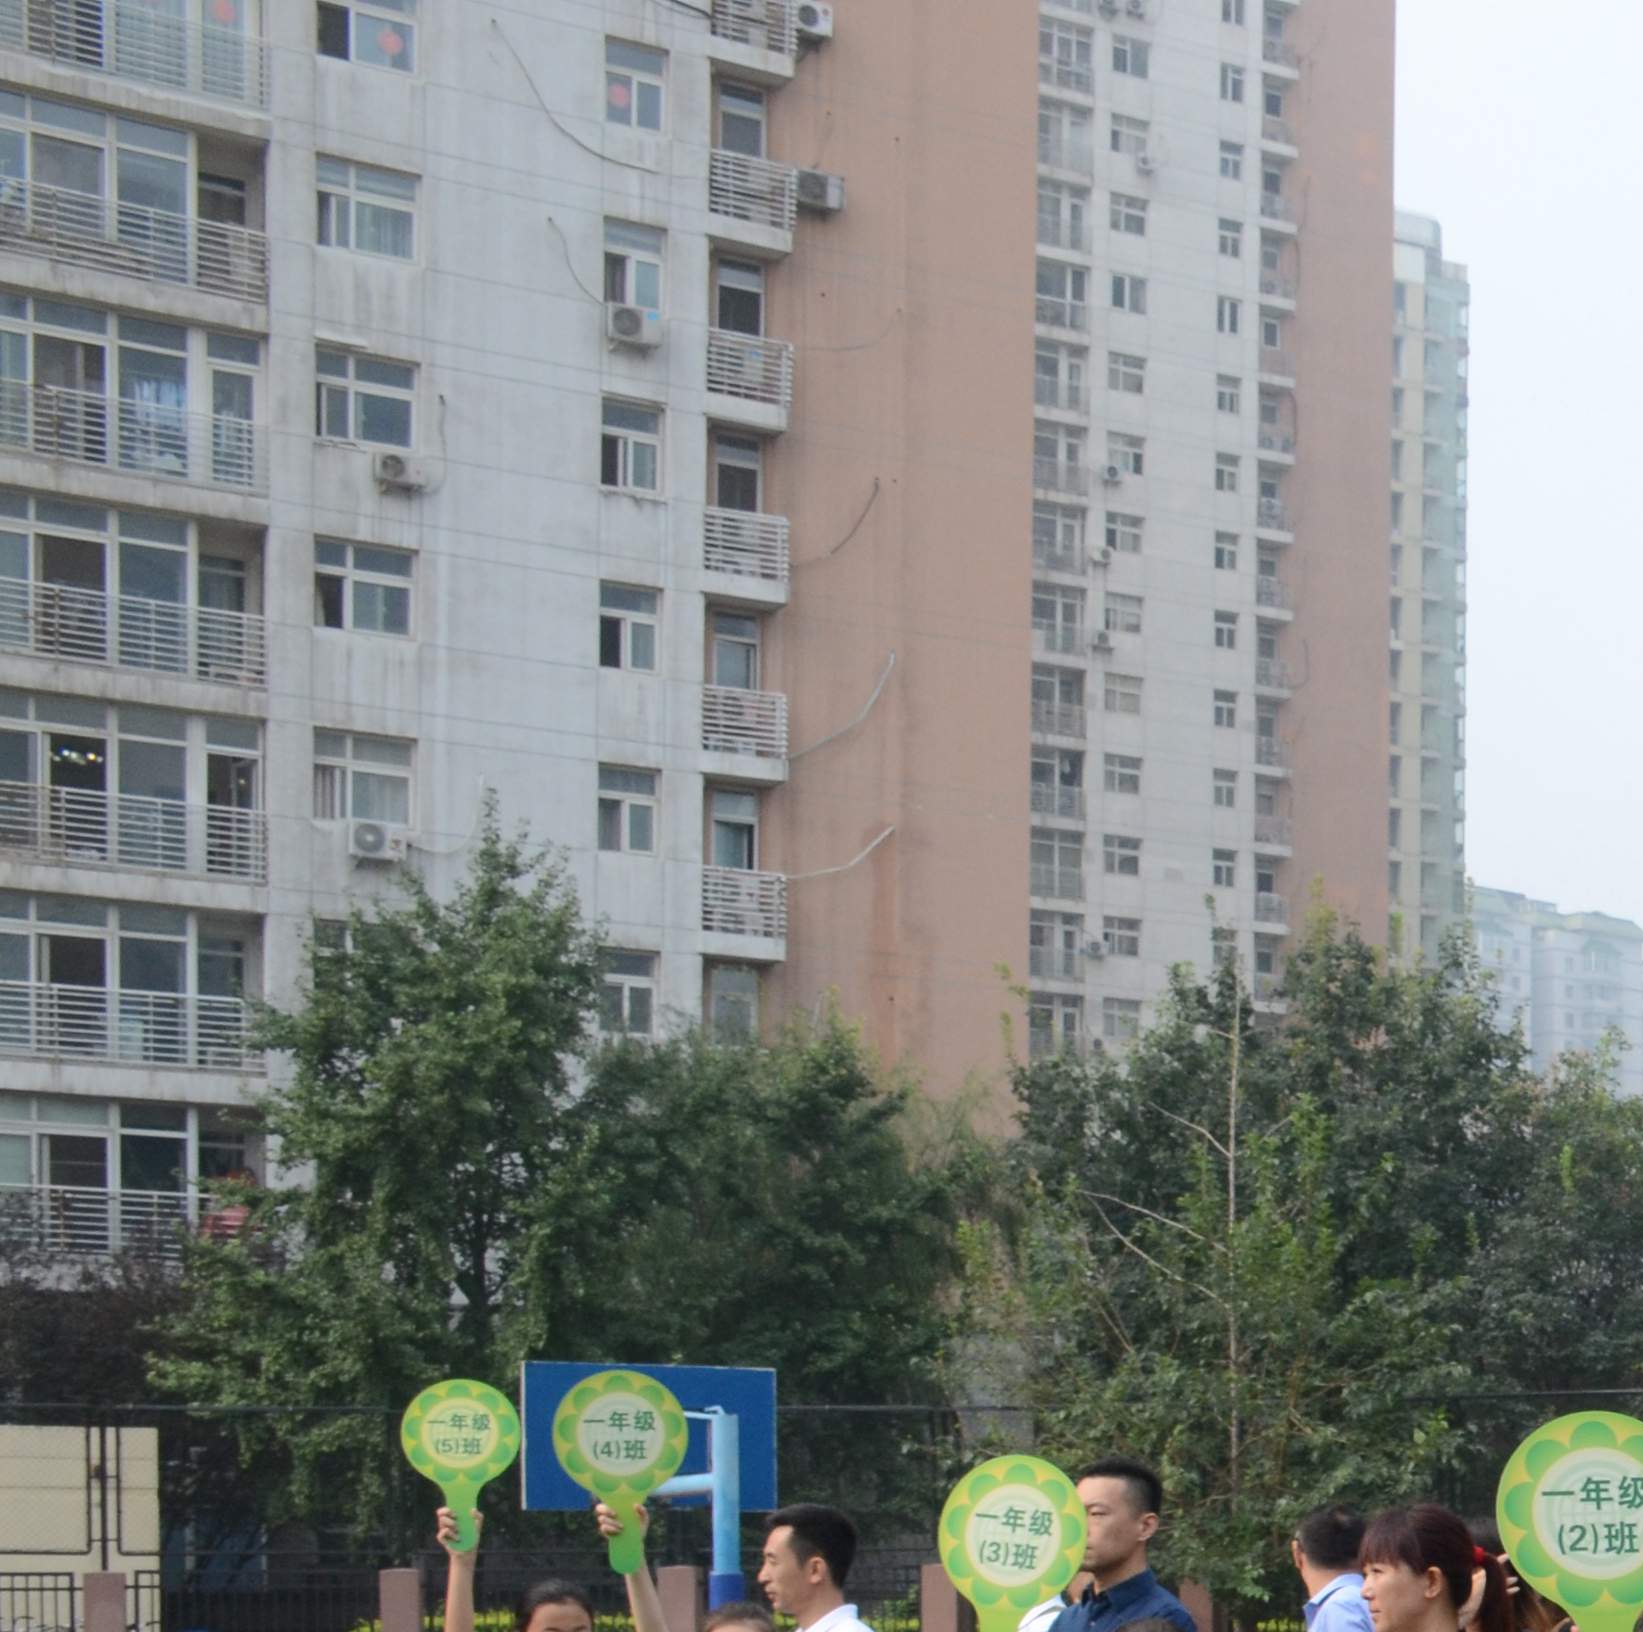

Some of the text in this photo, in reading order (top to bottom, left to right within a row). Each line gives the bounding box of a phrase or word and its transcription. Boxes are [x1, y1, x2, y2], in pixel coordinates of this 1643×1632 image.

[427, 1412, 491, 1432] 一年级
[584, 1409, 657, 1432] 一年级
[435, 1436, 483, 1456] (5)班
[592, 1437, 647, 1461] (4)班
[975, 1505, 1054, 1537] 一年级
[1557, 1521, 1640, 1556] (2)班
[979, 1540, 1039, 1571] (3)班
